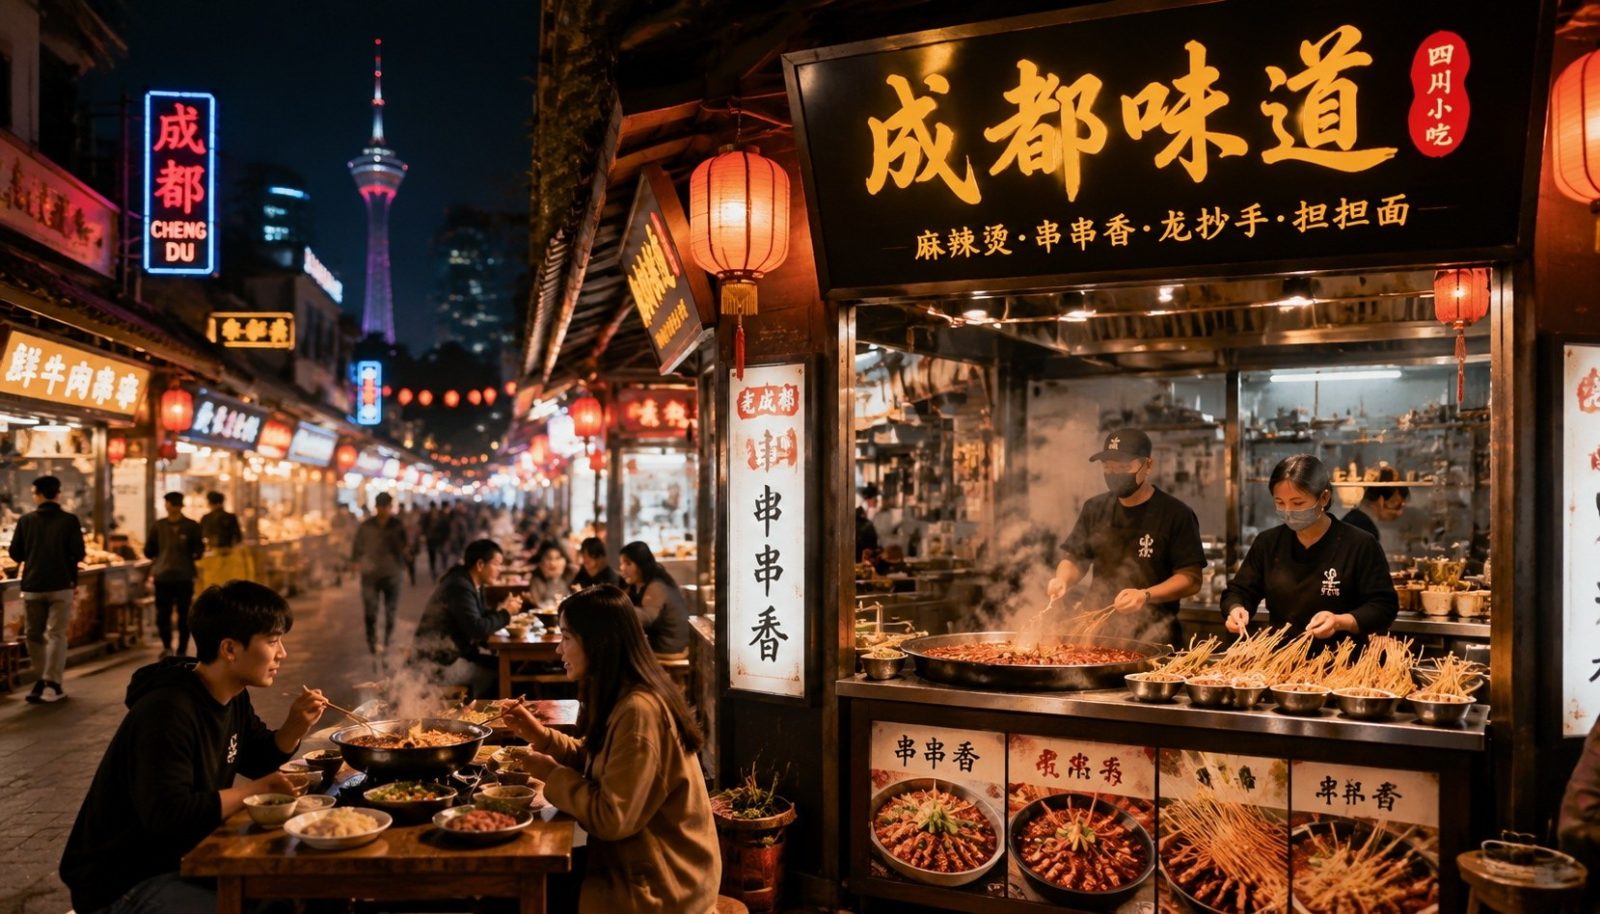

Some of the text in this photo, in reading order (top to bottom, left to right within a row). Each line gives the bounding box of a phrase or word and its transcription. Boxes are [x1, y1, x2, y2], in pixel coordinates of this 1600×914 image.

[866, 25, 1398, 204] 成都味道
[1425, 44, 1455, 146] 四川小吃
[153, 102, 206, 215] 成都
[151, 219, 207, 240] CHENG
[165, 241, 195, 263] DU
[749, 484, 790, 663] 串串香
[894, 734, 980, 774] 串串香
